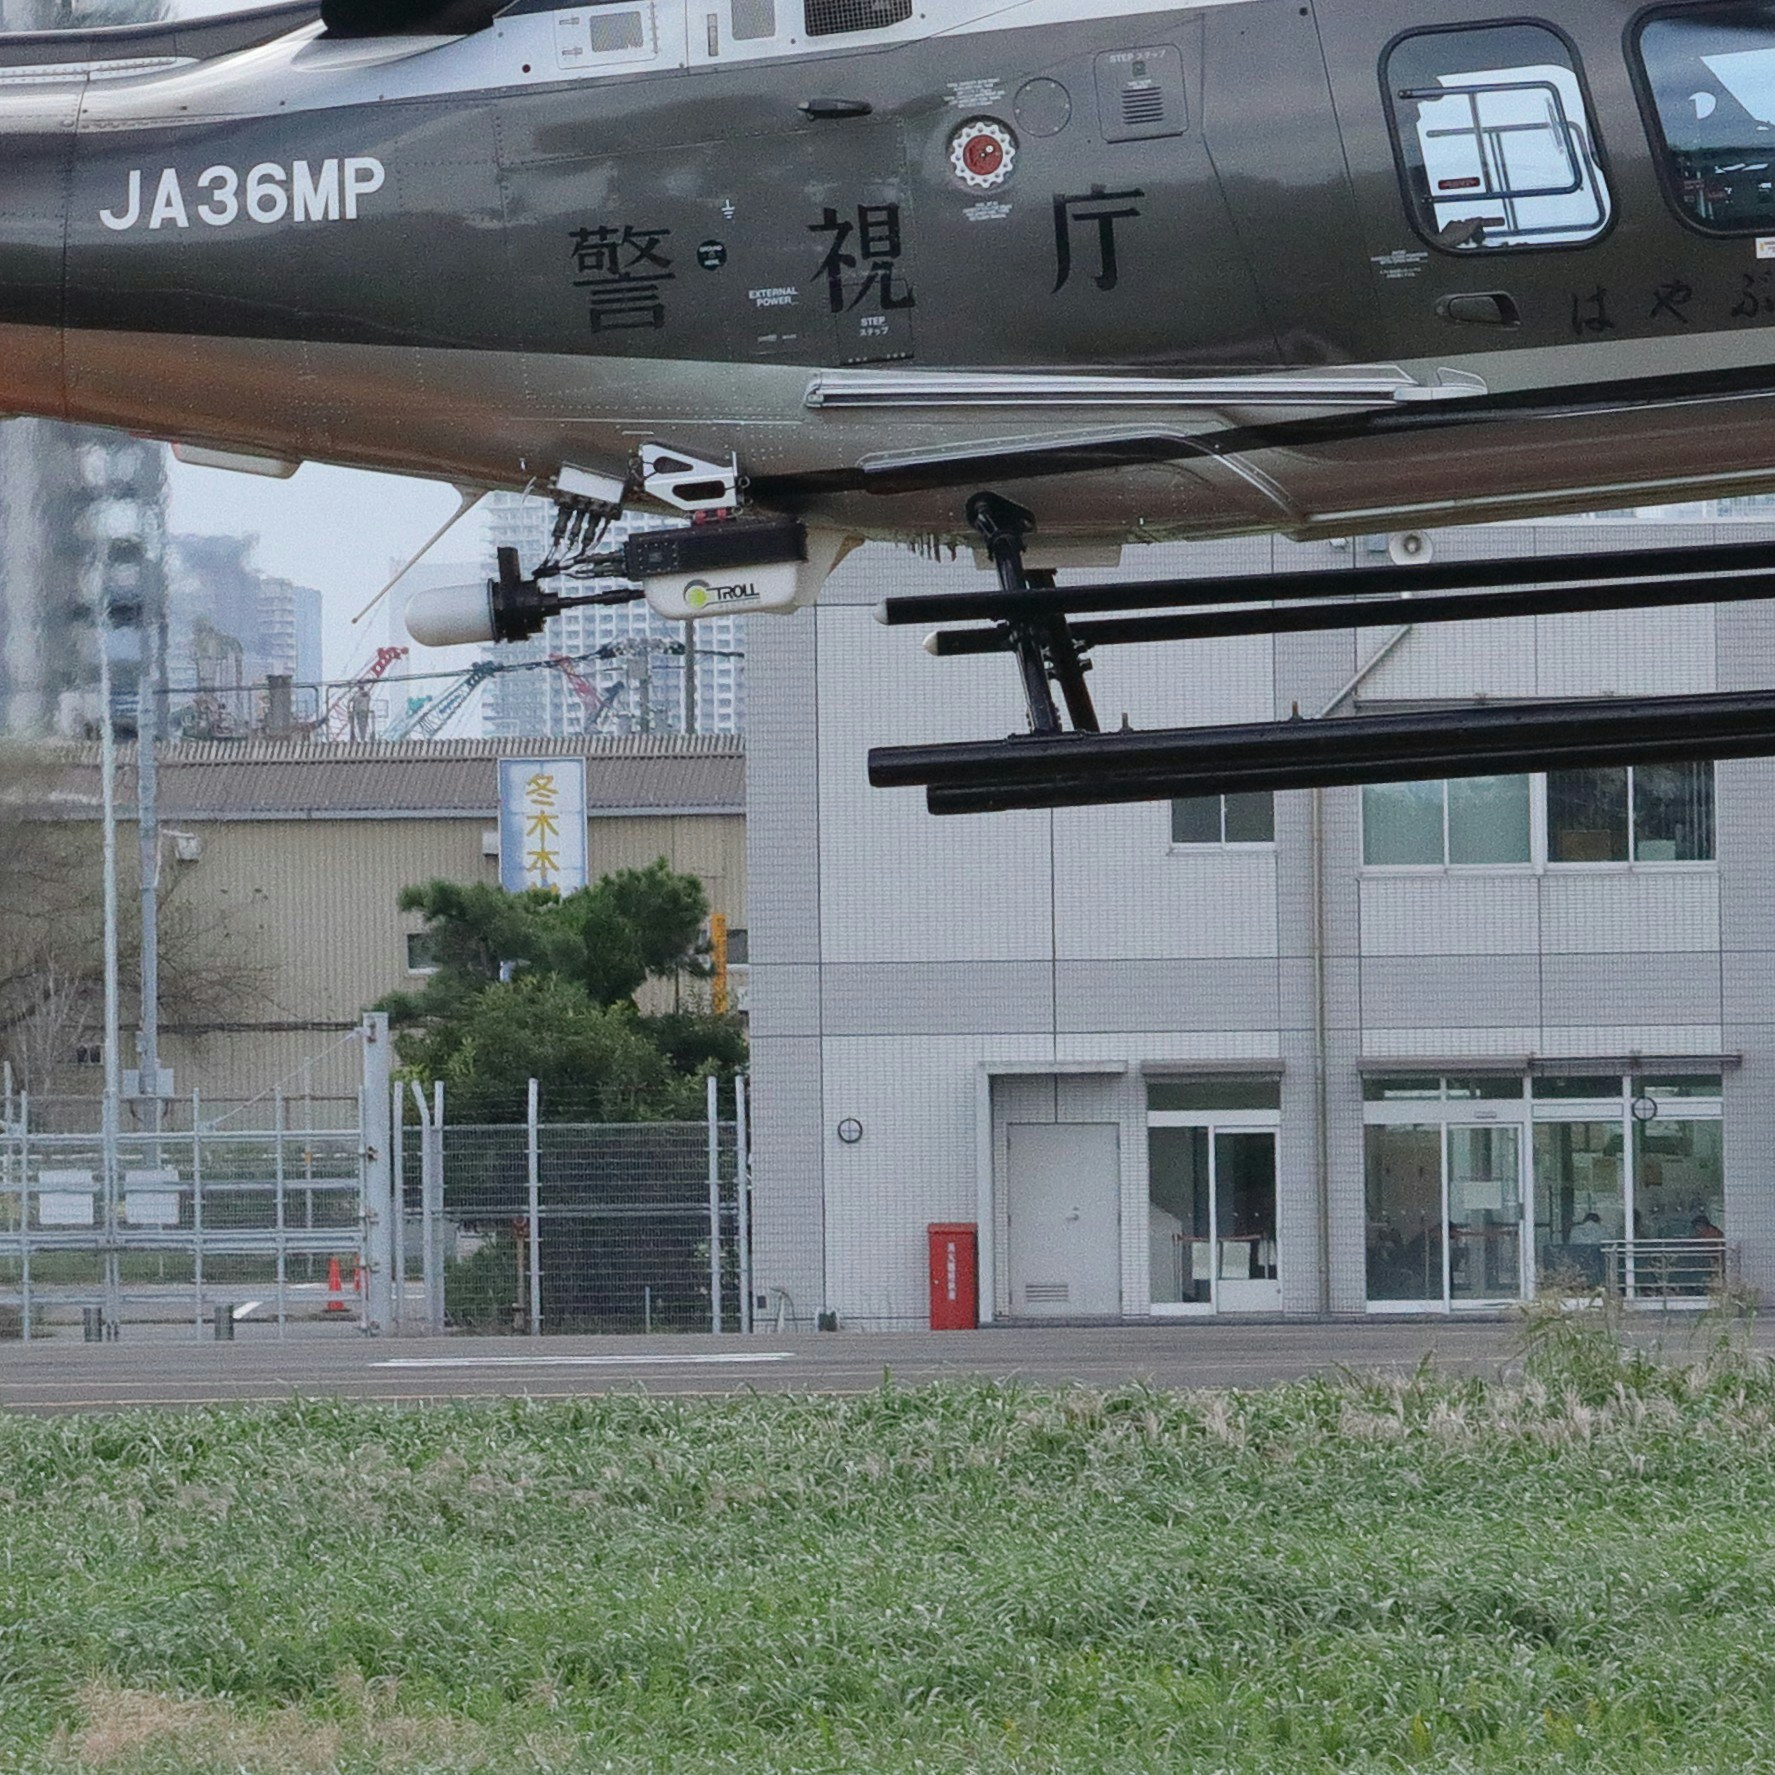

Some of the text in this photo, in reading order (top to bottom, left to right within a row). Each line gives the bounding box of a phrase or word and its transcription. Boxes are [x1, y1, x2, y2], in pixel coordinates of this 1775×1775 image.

[99, 157, 386, 231] JA36MP
[568, 183, 1145, 334] 警視庁
[748, 286, 799, 300] EXTERNAL
[756, 296, 792, 307] POWER
[860, 315, 887, 327] STEP
[859, 325, 890, 337] ステップ
[707, 582, 761, 601] TROLL
